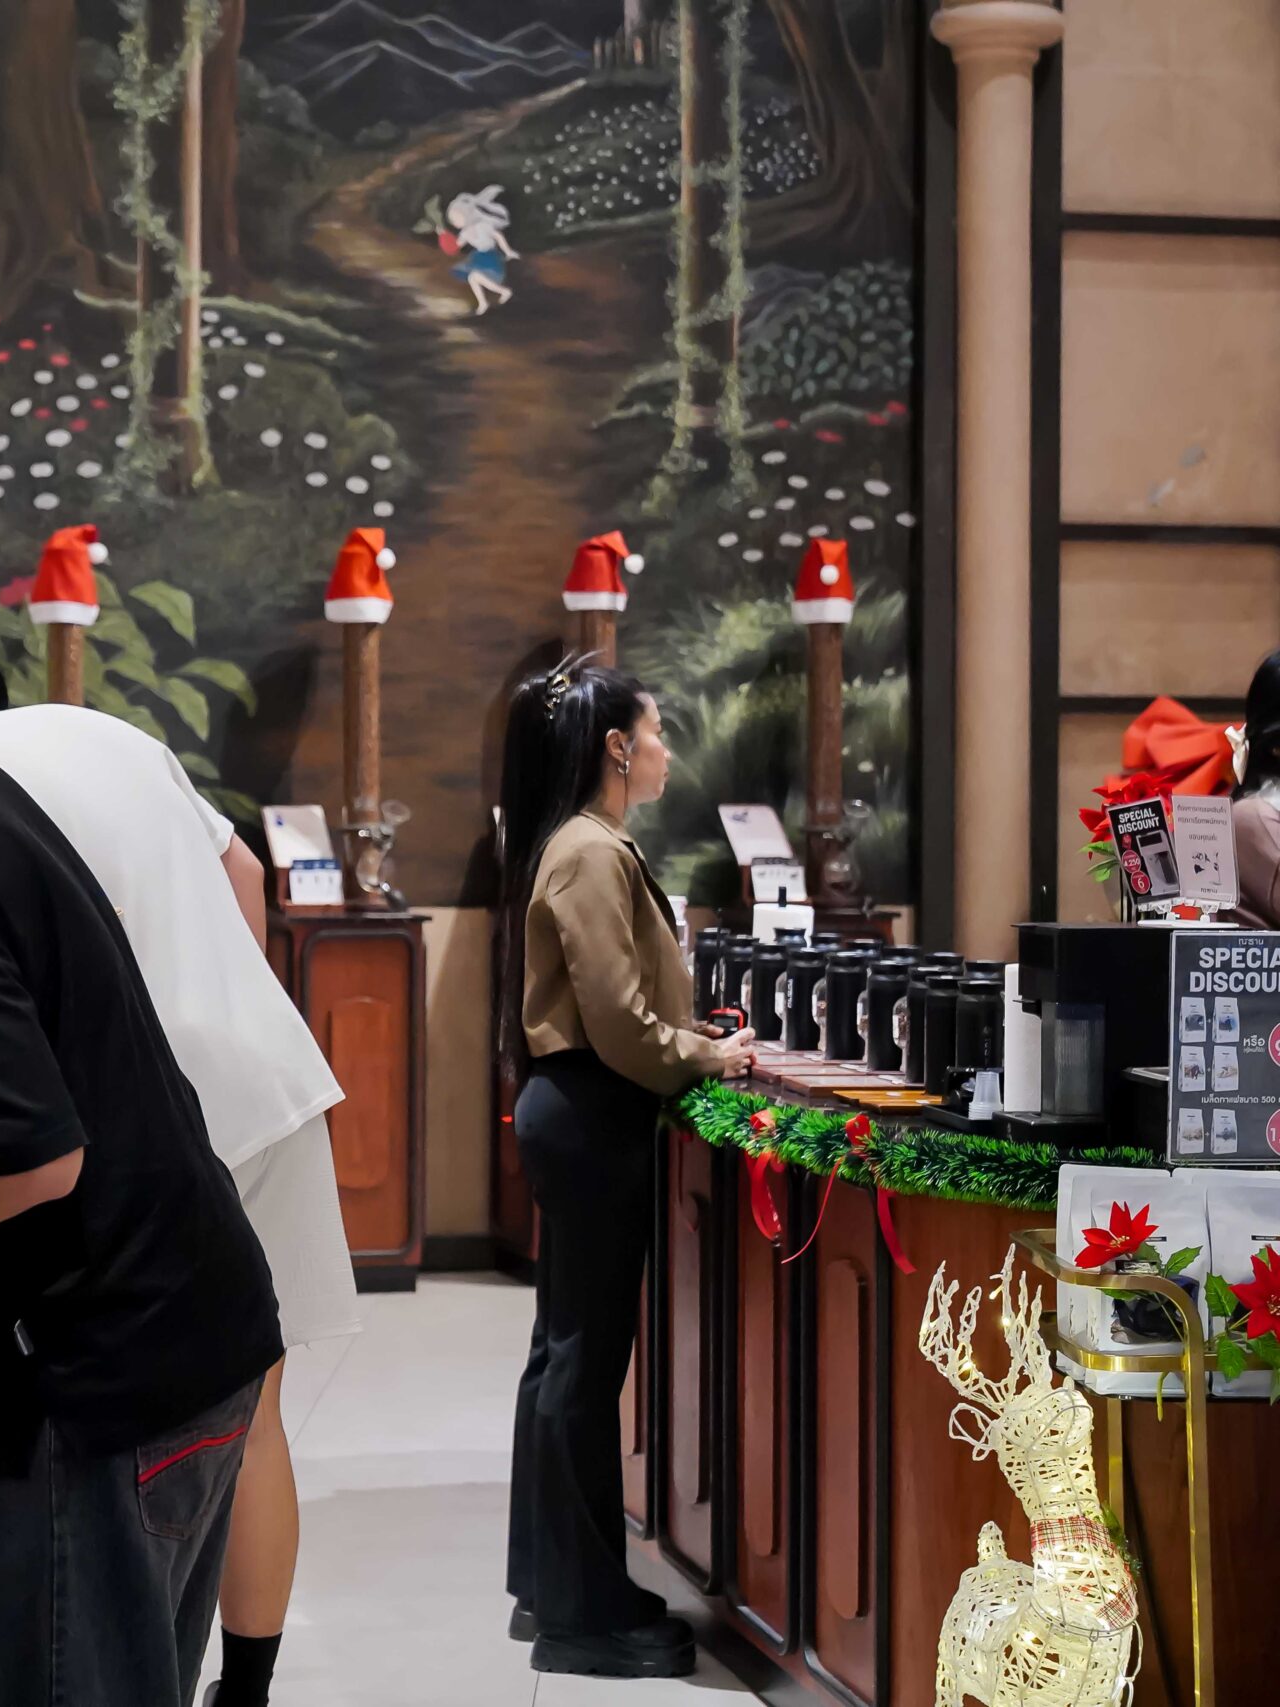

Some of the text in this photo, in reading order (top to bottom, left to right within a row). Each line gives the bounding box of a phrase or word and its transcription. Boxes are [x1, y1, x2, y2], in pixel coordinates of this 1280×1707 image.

[1119, 808, 1155, 823] SPECIAL
[1118, 817, 1159, 834] DISCOUNT
[1189, 971, 1280, 993] DISCOU
[1261, 1095, 1276, 1104] 500
